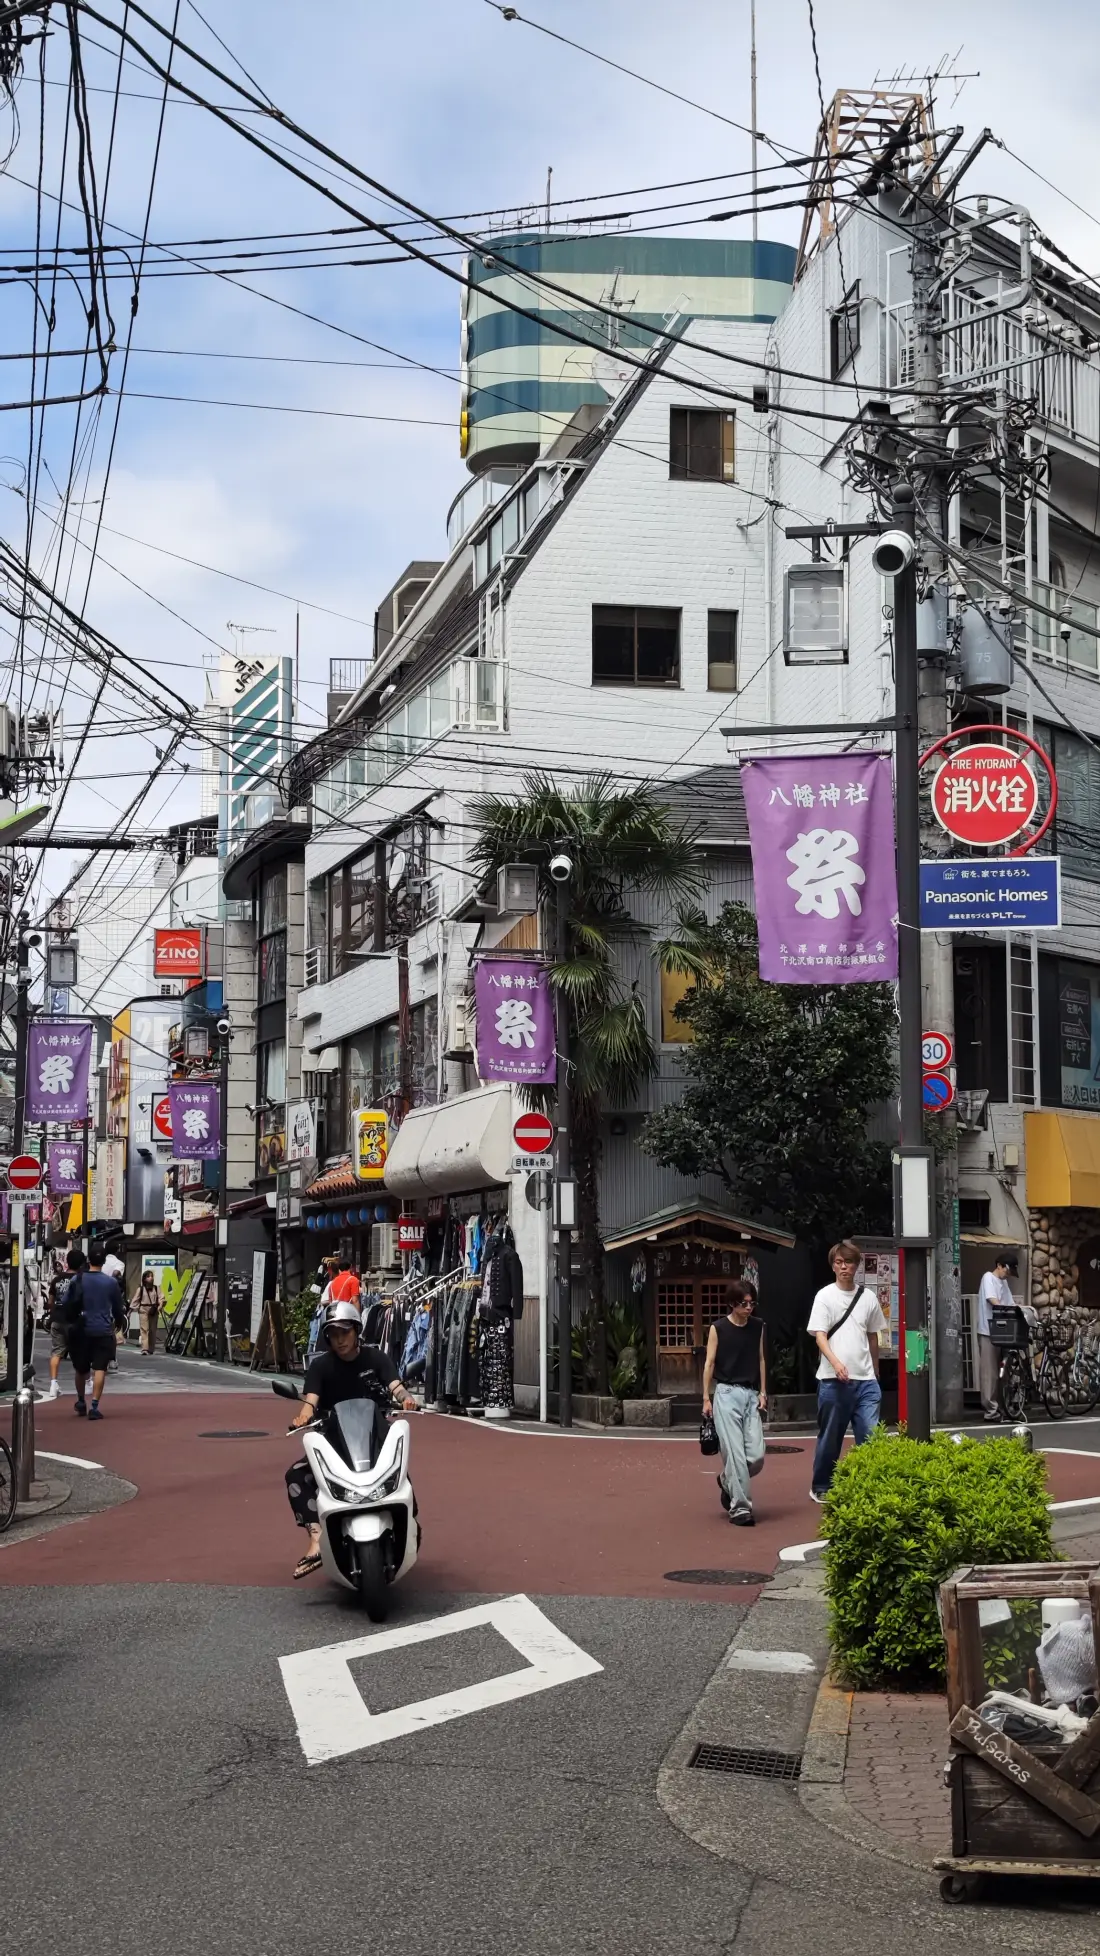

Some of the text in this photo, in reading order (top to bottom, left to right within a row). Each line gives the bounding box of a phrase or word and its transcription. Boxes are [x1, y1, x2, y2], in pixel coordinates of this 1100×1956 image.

[976, 652, 992, 663] 75
[951, 758, 1018, 770] FIRE HYDRANT
[768, 782, 869, 809] 八幡神社
[943, 776, 1028, 814] 消火栓
[785, 828, 866, 919] 祭
[961, 868, 1030, 879] 街を、家でまもろう。
[926, 888, 1048, 903] Panasonic Homes
[991, 911, 1013, 919] PLT
[157, 948, 198, 959] ZINO
[488, 974, 540, 990] 八幡神社
[495, 999, 537, 1049] 祭
[37, 1035, 81, 1046] 八幡神社
[922, 1043, 943, 1059] 30
[39, 1055, 74, 1094] 祭
[176, 1093, 211, 1103] 八幡神社
[182, 1109, 209, 1139] 祭
[58, 1159, 77, 1179] 祭
[515, 1158, 550, 1168] 自転車を除く
[400, 1226, 424, 1239] SALE
[959, 1716, 1031, 1783] Bulsaras
